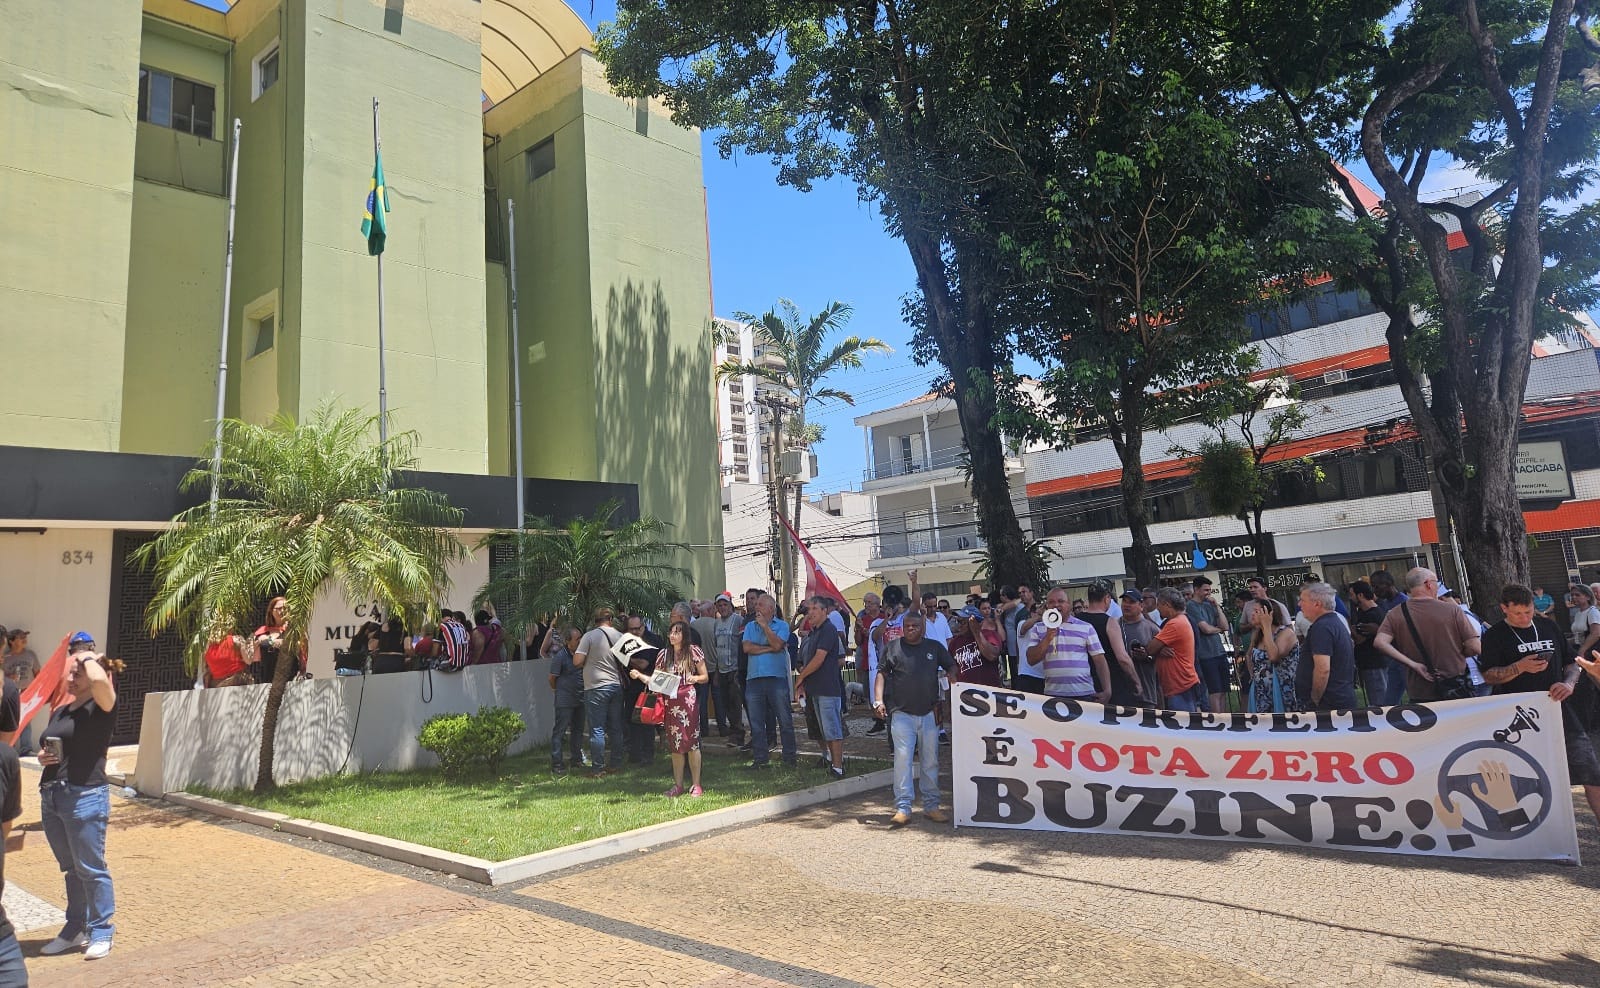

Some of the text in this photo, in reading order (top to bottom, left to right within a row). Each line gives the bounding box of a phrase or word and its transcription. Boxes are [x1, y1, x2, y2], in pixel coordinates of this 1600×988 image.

[61, 551, 94, 565] 834
[960, 688, 1438, 733] SE O PREFEITO
[981, 728, 1415, 786] É NOTA ZERO
[970, 775, 1437, 851] BUZINE!
